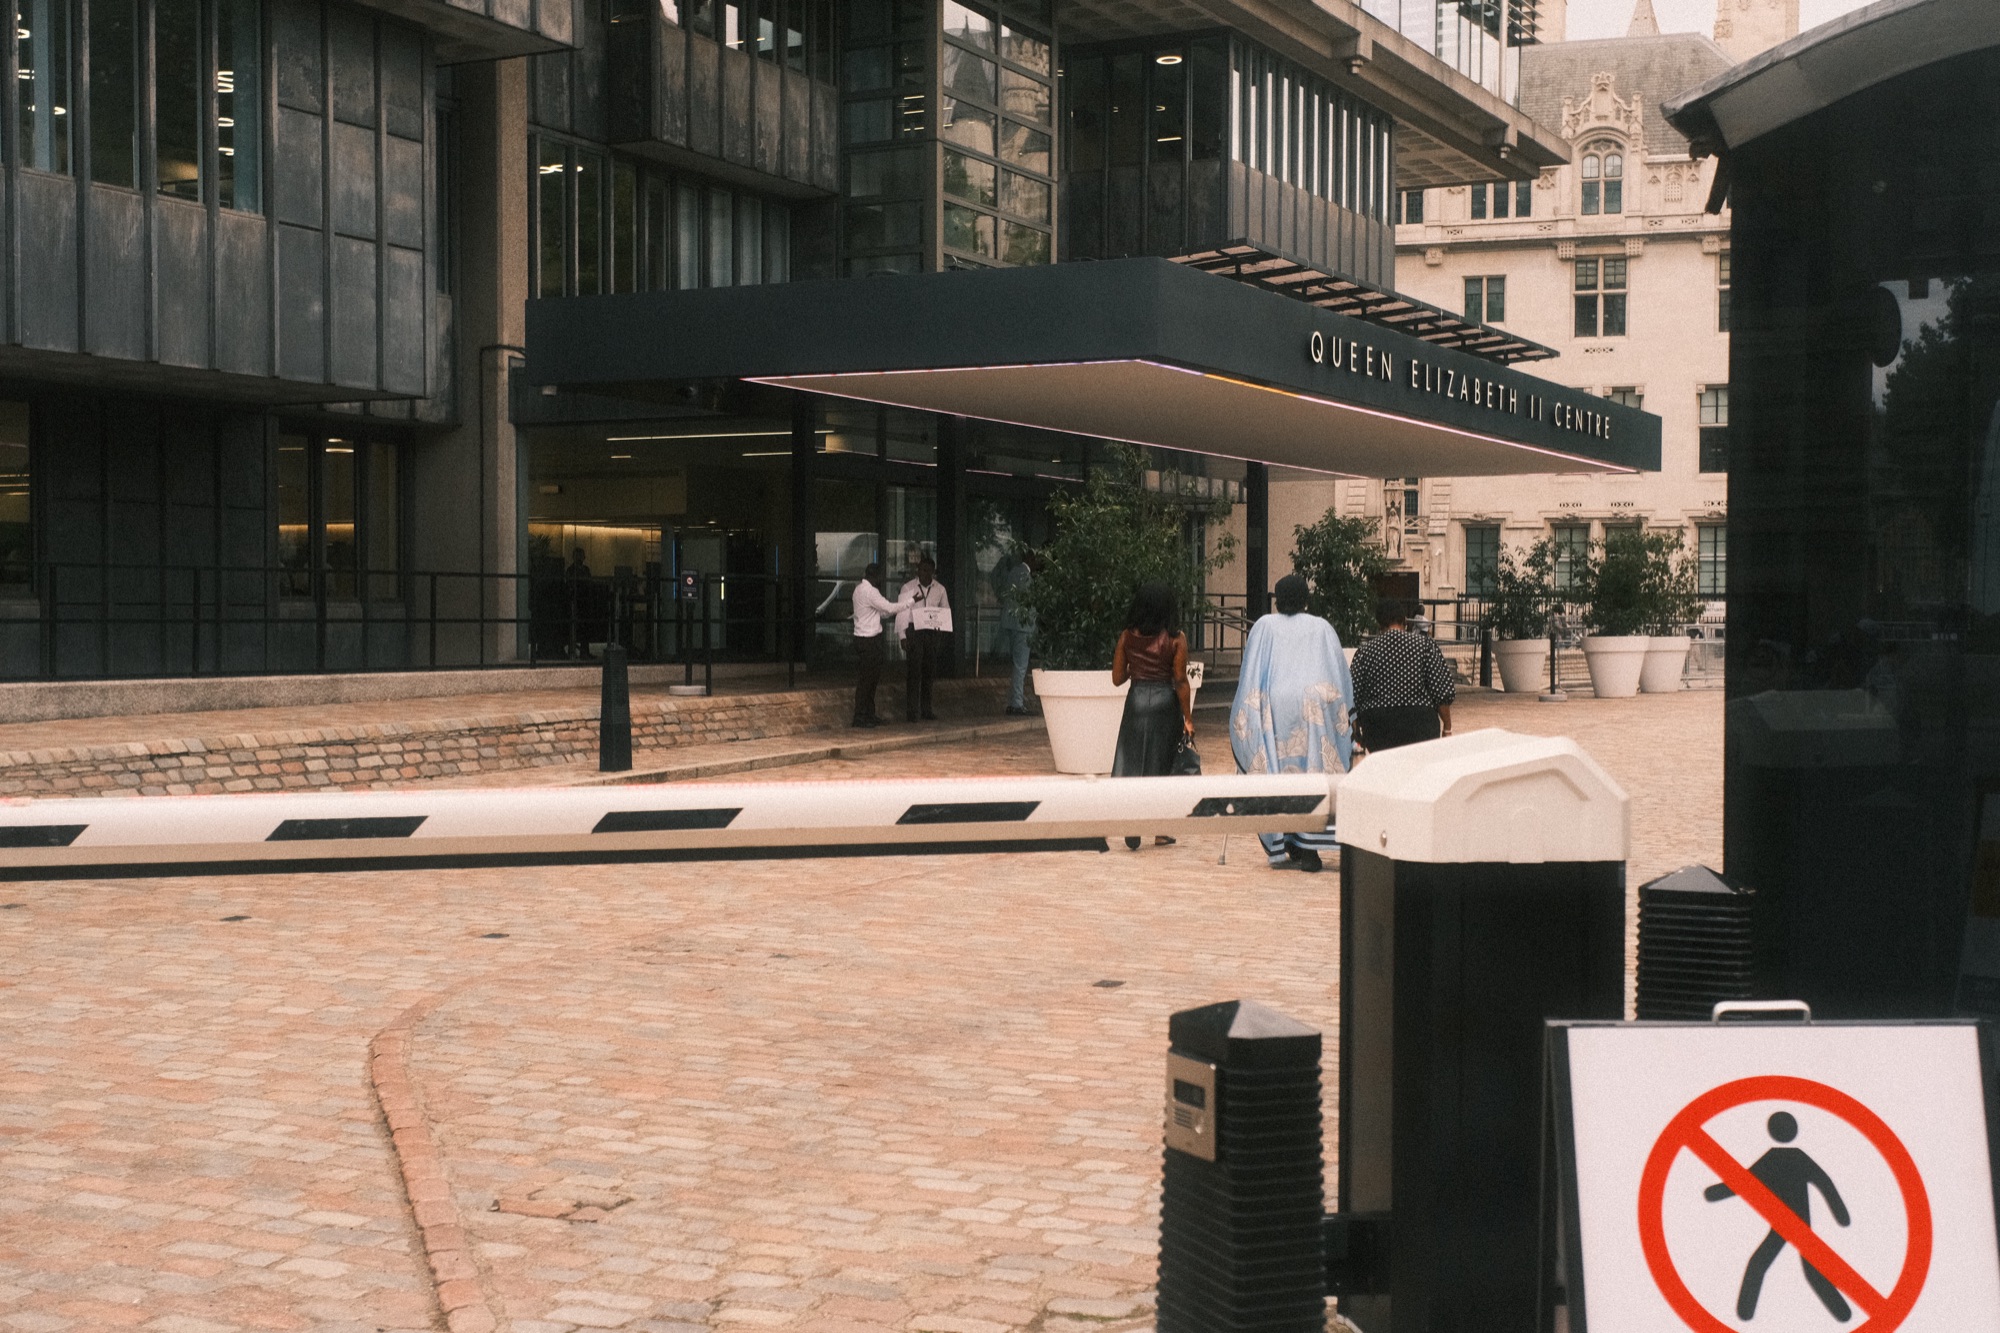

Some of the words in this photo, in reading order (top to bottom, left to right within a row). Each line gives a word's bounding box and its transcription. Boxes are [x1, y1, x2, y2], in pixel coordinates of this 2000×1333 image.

[1310, 330, 1392, 381] QUEEN
[1411, 358, 1517, 415] ELIZABETH
[1530, 394, 1543, 421] II
[1553, 402, 1610, 440] CENTRE
